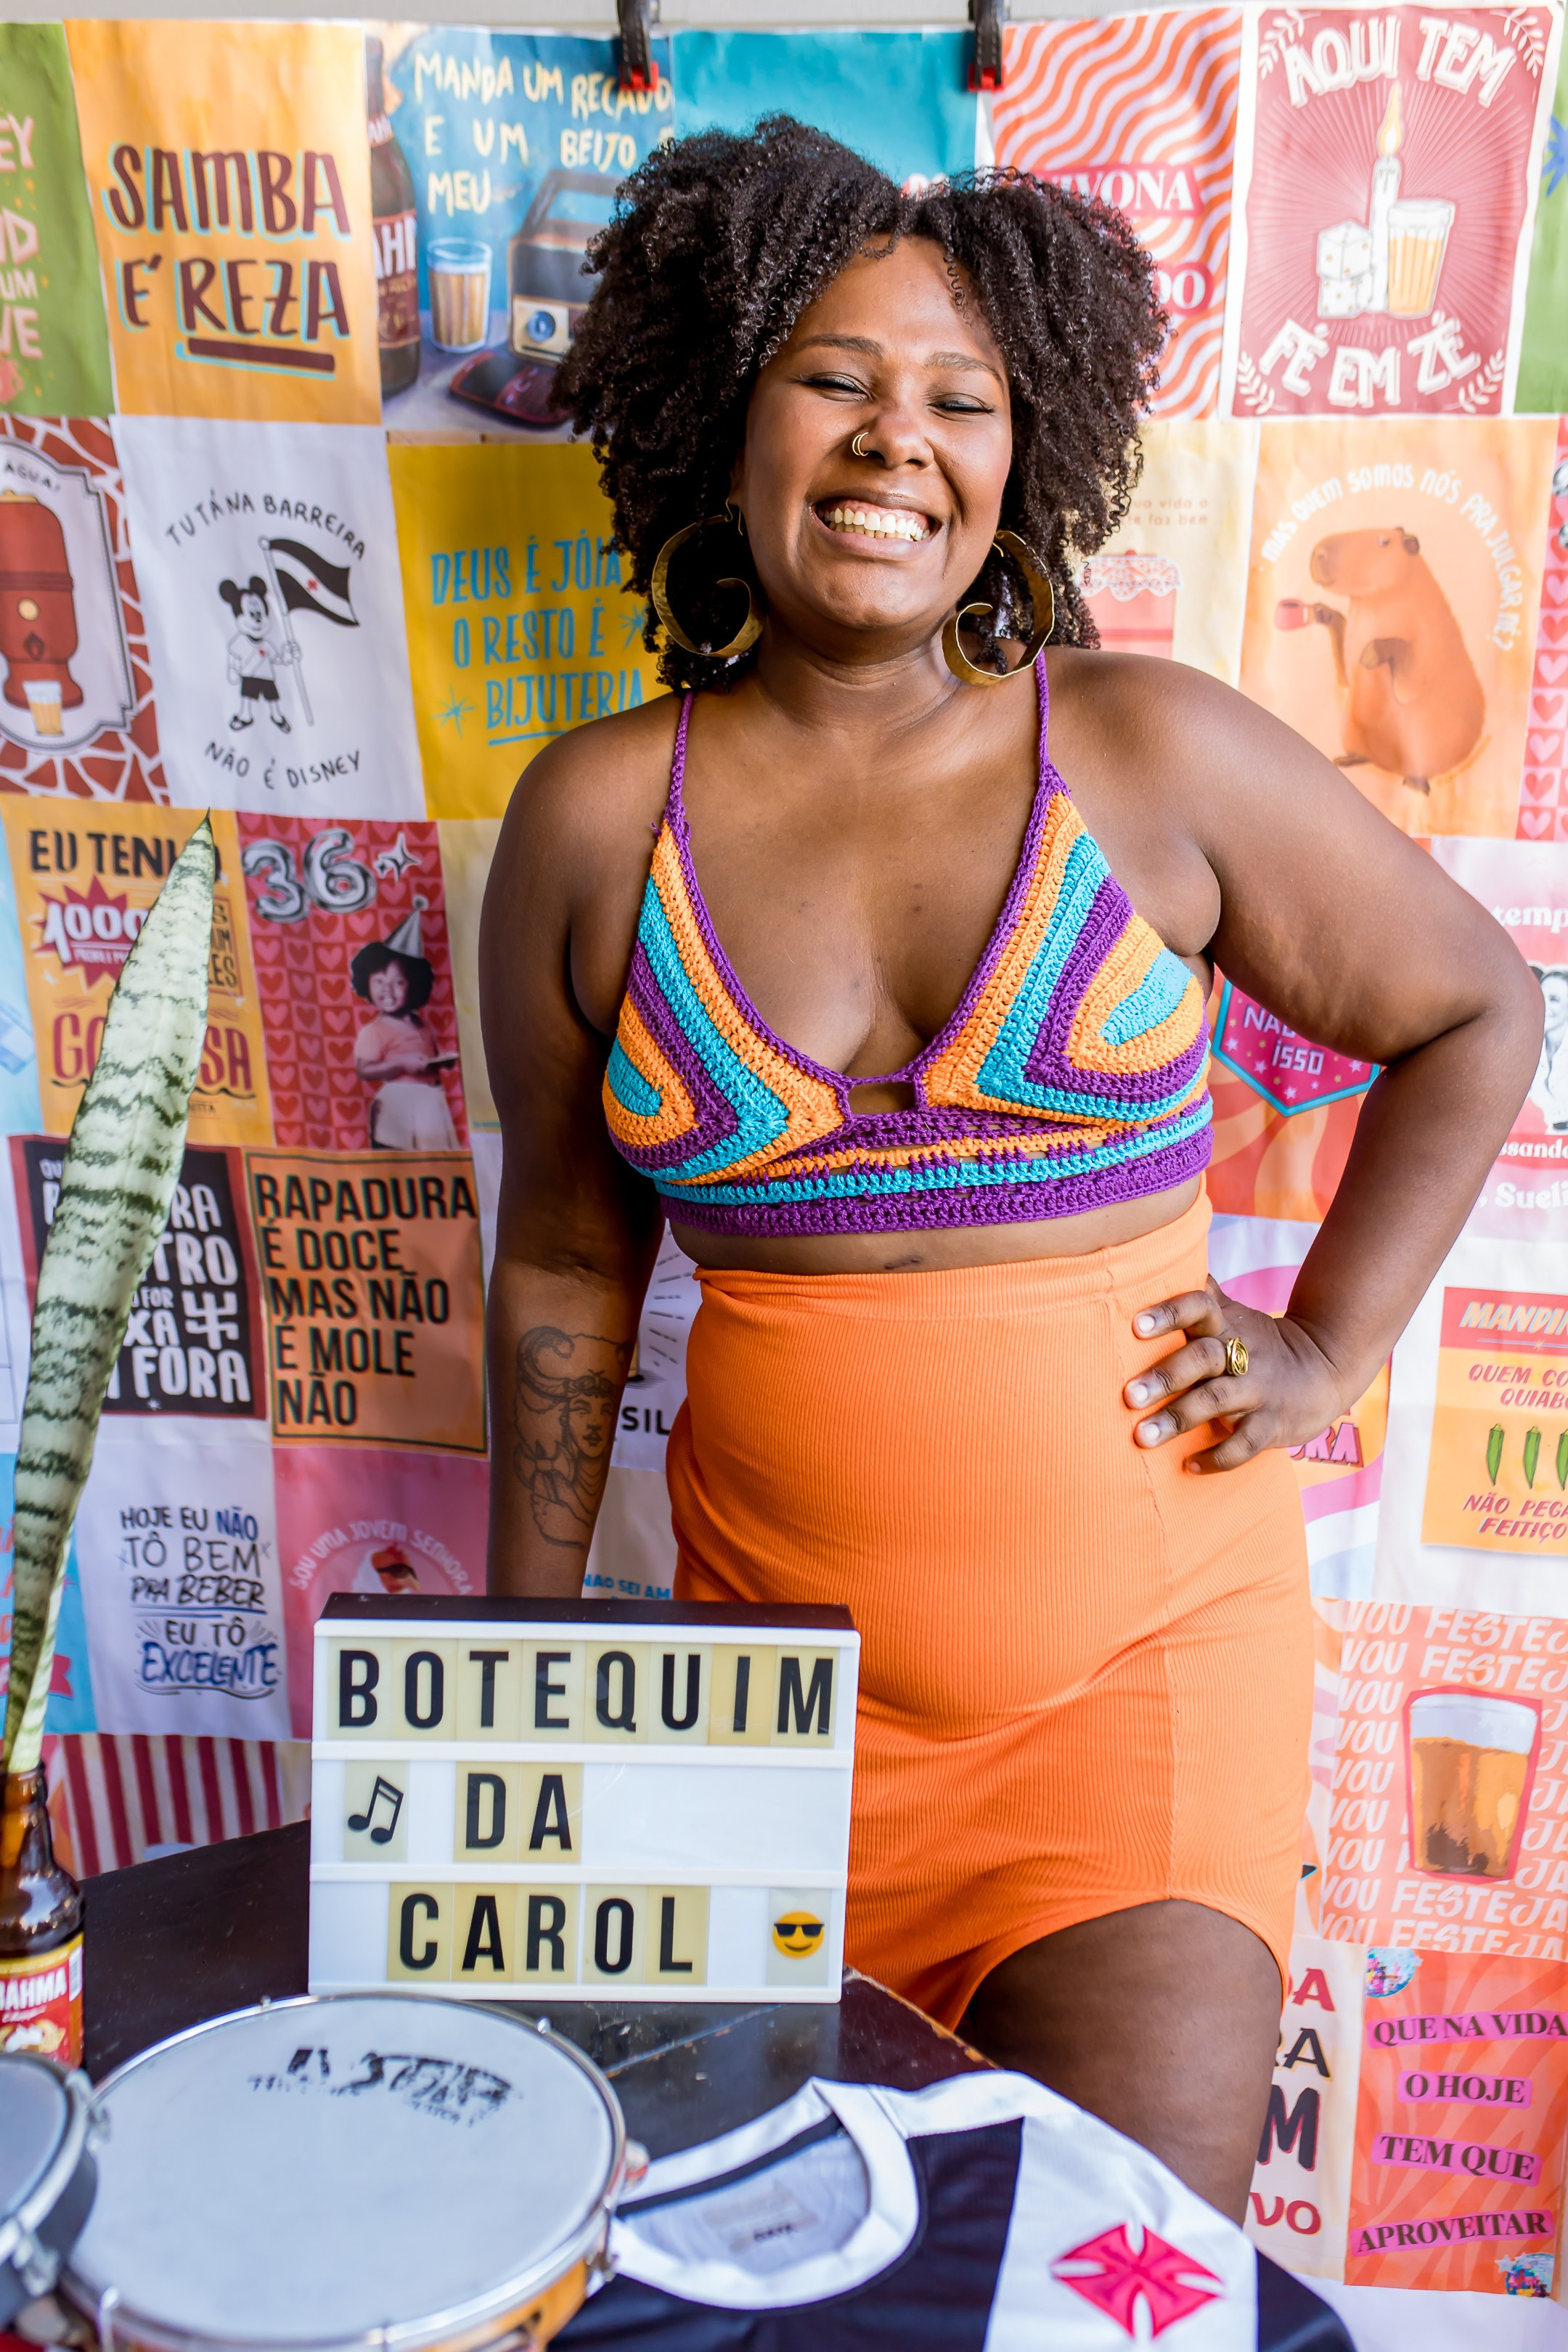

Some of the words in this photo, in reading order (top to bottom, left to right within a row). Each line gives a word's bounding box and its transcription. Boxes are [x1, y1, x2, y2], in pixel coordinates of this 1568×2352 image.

[414, 52, 514, 105] MANDA
[523, 61, 564, 105] UM
[1282, 15, 1401, 109] AQUI
[1416, 16, 1519, 109] TEM
[425, 115, 446, 156] E
[473, 118, 530, 166] UM
[560, 128, 637, 173] BEIJO
[105, 143, 352, 241] SAMBA
[427, 169, 492, 217] MEU
[176, 258, 351, 342] REZA
[1259, 317, 1330, 398] FÉ
[1327, 344, 1402, 409] EM
[1406, 309, 1482, 396] ZÉ
[165, 513, 196, 547] TU
[224, 491, 256, 515] NA
[262, 493, 367, 562] BARREIRA
[1458, 492, 1500, 537] PRA
[1485, 530, 1524, 610] JULGAR
[430, 546, 513, 606] DEUS
[524, 534, 542, 595] É
[551, 527, 623, 594] JÓIA
[452, 617, 471, 669] O
[481, 606, 576, 666] RESTO
[589, 597, 605, 658] É
[485, 668, 645, 730] BIJUTERIA
[204, 740, 250, 779] NÃO
[263, 758, 277, 791] É
[286, 749, 362, 789] DISNEY
[29, 830, 79, 873] EU
[242, 826, 377, 924] 36
[253, 1172, 478, 1223] RAPADURA
[264, 1217, 286, 1271] É
[296, 1228, 404, 1273] DOCE
[266, 1275, 357, 1320] MAS
[368, 1270, 452, 1326] NÃO
[131, 1345, 251, 1404] FORA
[276, 1315, 297, 1371] É
[309, 1326, 415, 1378] MOLE
[1468, 1363, 1532, 1385] QUEM
[277, 1371, 359, 1427] NÃO
[1499, 1387, 1568, 1410] QUIAB
[121, 1505, 173, 1530] HOJE
[180, 1506, 209, 1532] EU
[216, 1506, 258, 1542] NÃO
[1477, 1517, 1568, 1545] FEITIÇO
[123, 1531, 167, 1569] TÔ
[184, 1535, 261, 1579] BEM
[287, 1554, 318, 1591] SOU
[309, 1527, 351, 1559] UMA
[348, 1519, 408, 1543] JOVEM
[410, 1528, 475, 1596] SENHORA
[131, 1575, 171, 1603] PRA
[176, 1574, 266, 1609] BEBER
[166, 1620, 196, 1646] EU
[211, 1615, 246, 1647] TÔ
[1342, 1639, 1409, 1675] VOU
[140, 1641, 279, 1689] EXCELENTE
[338, 1649, 834, 1736] BOTEQUIM
[465, 1772, 573, 1852] DA
[399, 1892, 694, 1975] CAROL
[1373, 2016, 1437, 2048] QUE
[1442, 2014, 1485, 2040] NA
[1489, 2011, 1568, 2038] VIDA
[1404, 2073, 1430, 2099] O
[1434, 2073, 1526, 2104] HOJE
[1379, 2135, 1455, 2169] TEM
[1460, 2145, 1536, 2181] QUE
[1355, 2210, 1550, 2253] APROVEITAR
